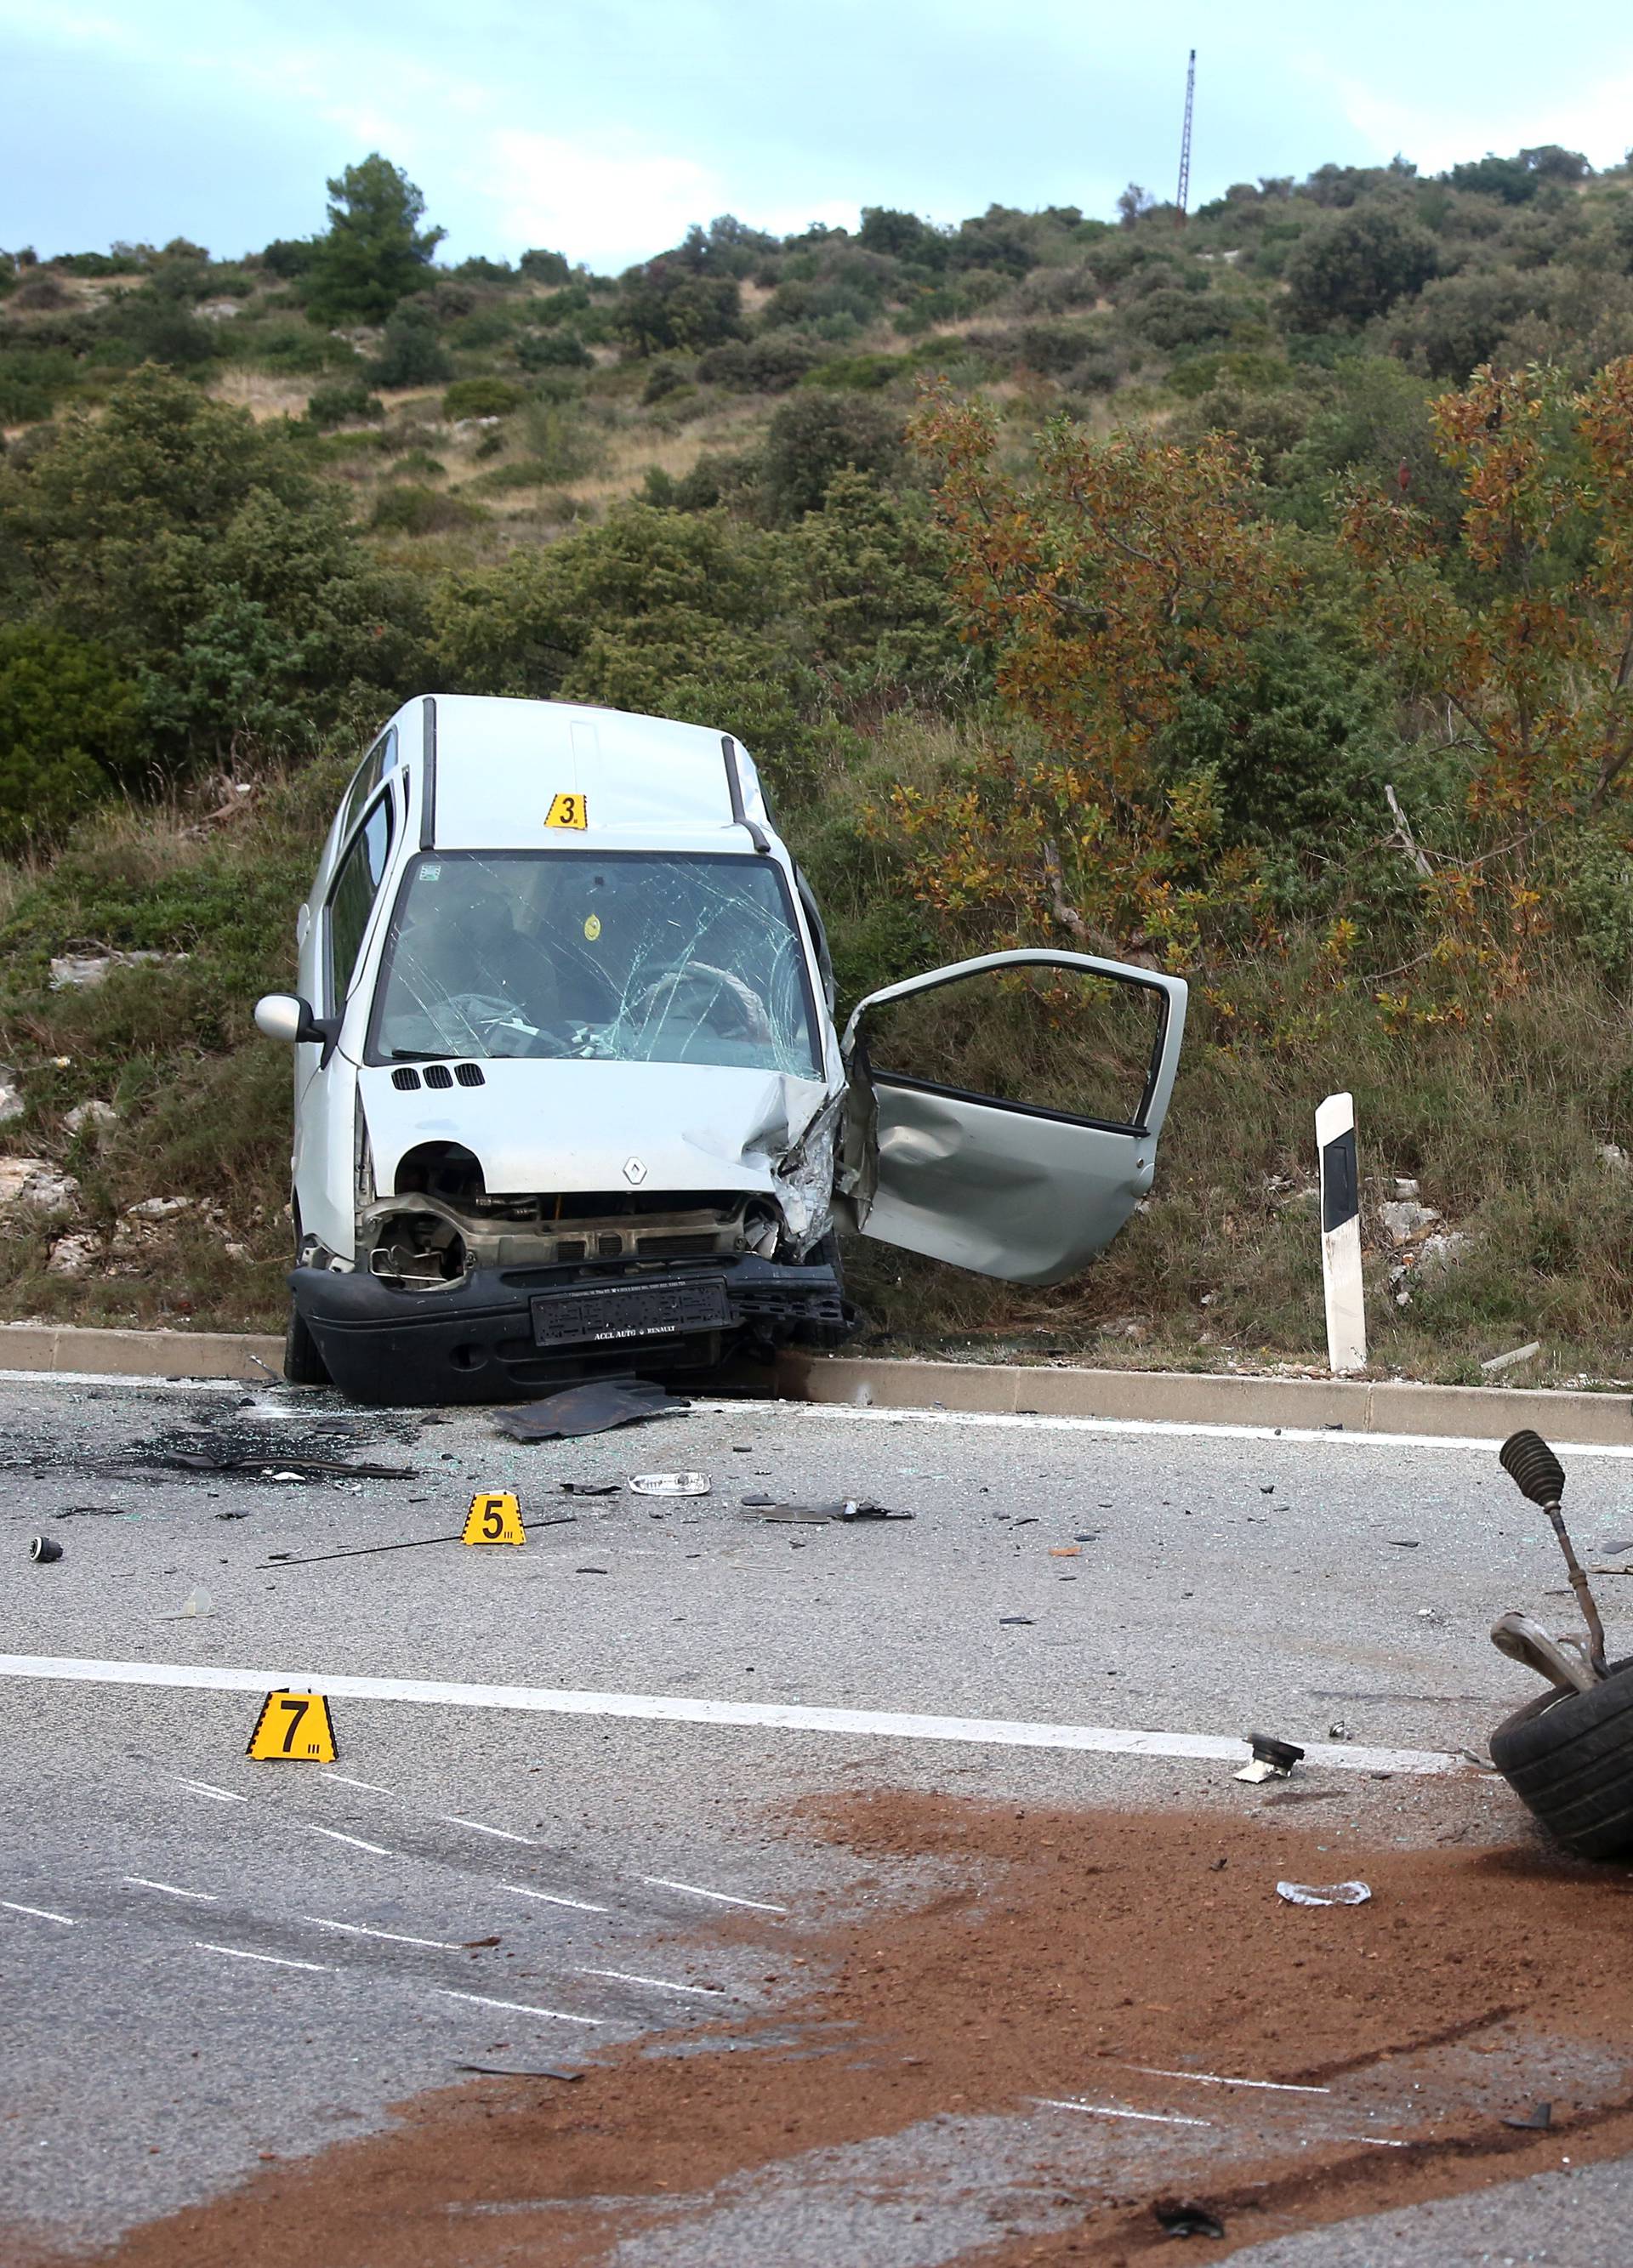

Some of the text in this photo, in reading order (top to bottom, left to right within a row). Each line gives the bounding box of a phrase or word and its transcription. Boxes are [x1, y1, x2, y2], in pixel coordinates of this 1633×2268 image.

[560, 797, 575, 824] 3
[646, 1326, 675, 1334] RENAULT
[482, 1500, 504, 1539] 5
[281, 1700, 310, 1753] 7
